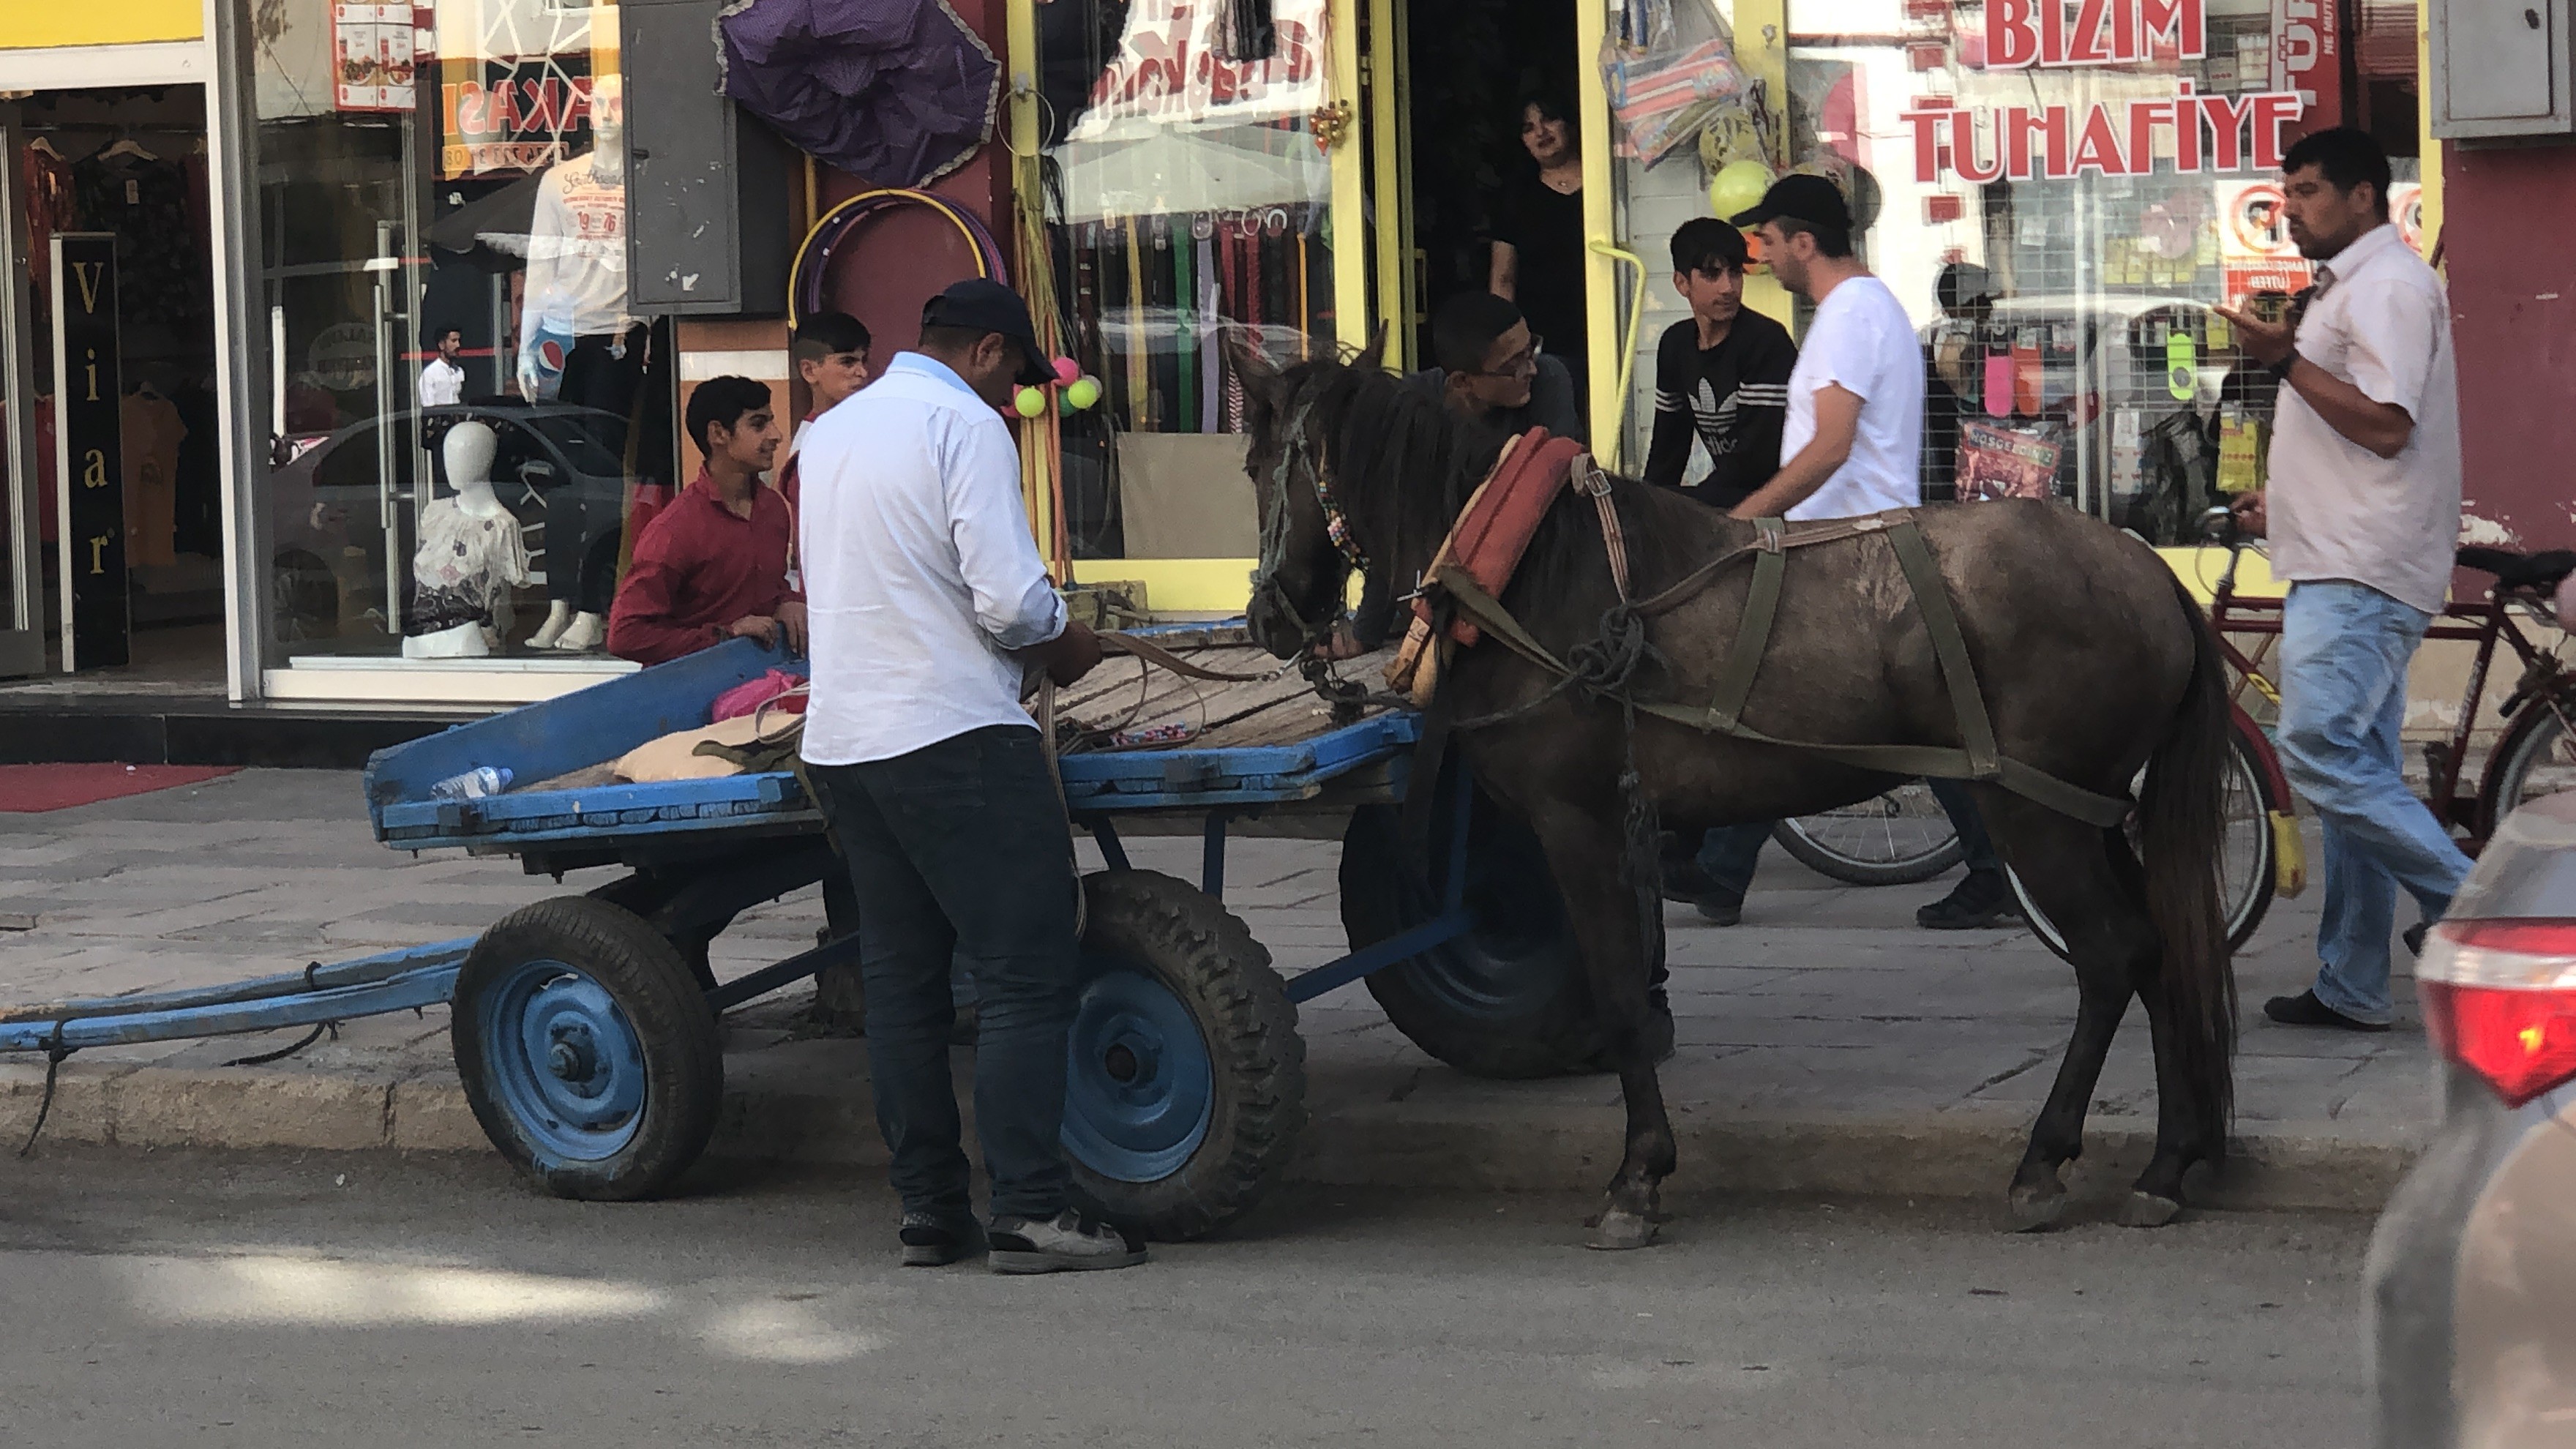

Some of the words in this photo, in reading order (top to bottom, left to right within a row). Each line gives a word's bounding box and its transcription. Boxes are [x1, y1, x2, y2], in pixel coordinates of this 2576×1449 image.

[2322, 0, 2334, 32] MUT
[1898, 77, 2304, 183] TUHAFİYE
[73, 261, 109, 575] Viar
